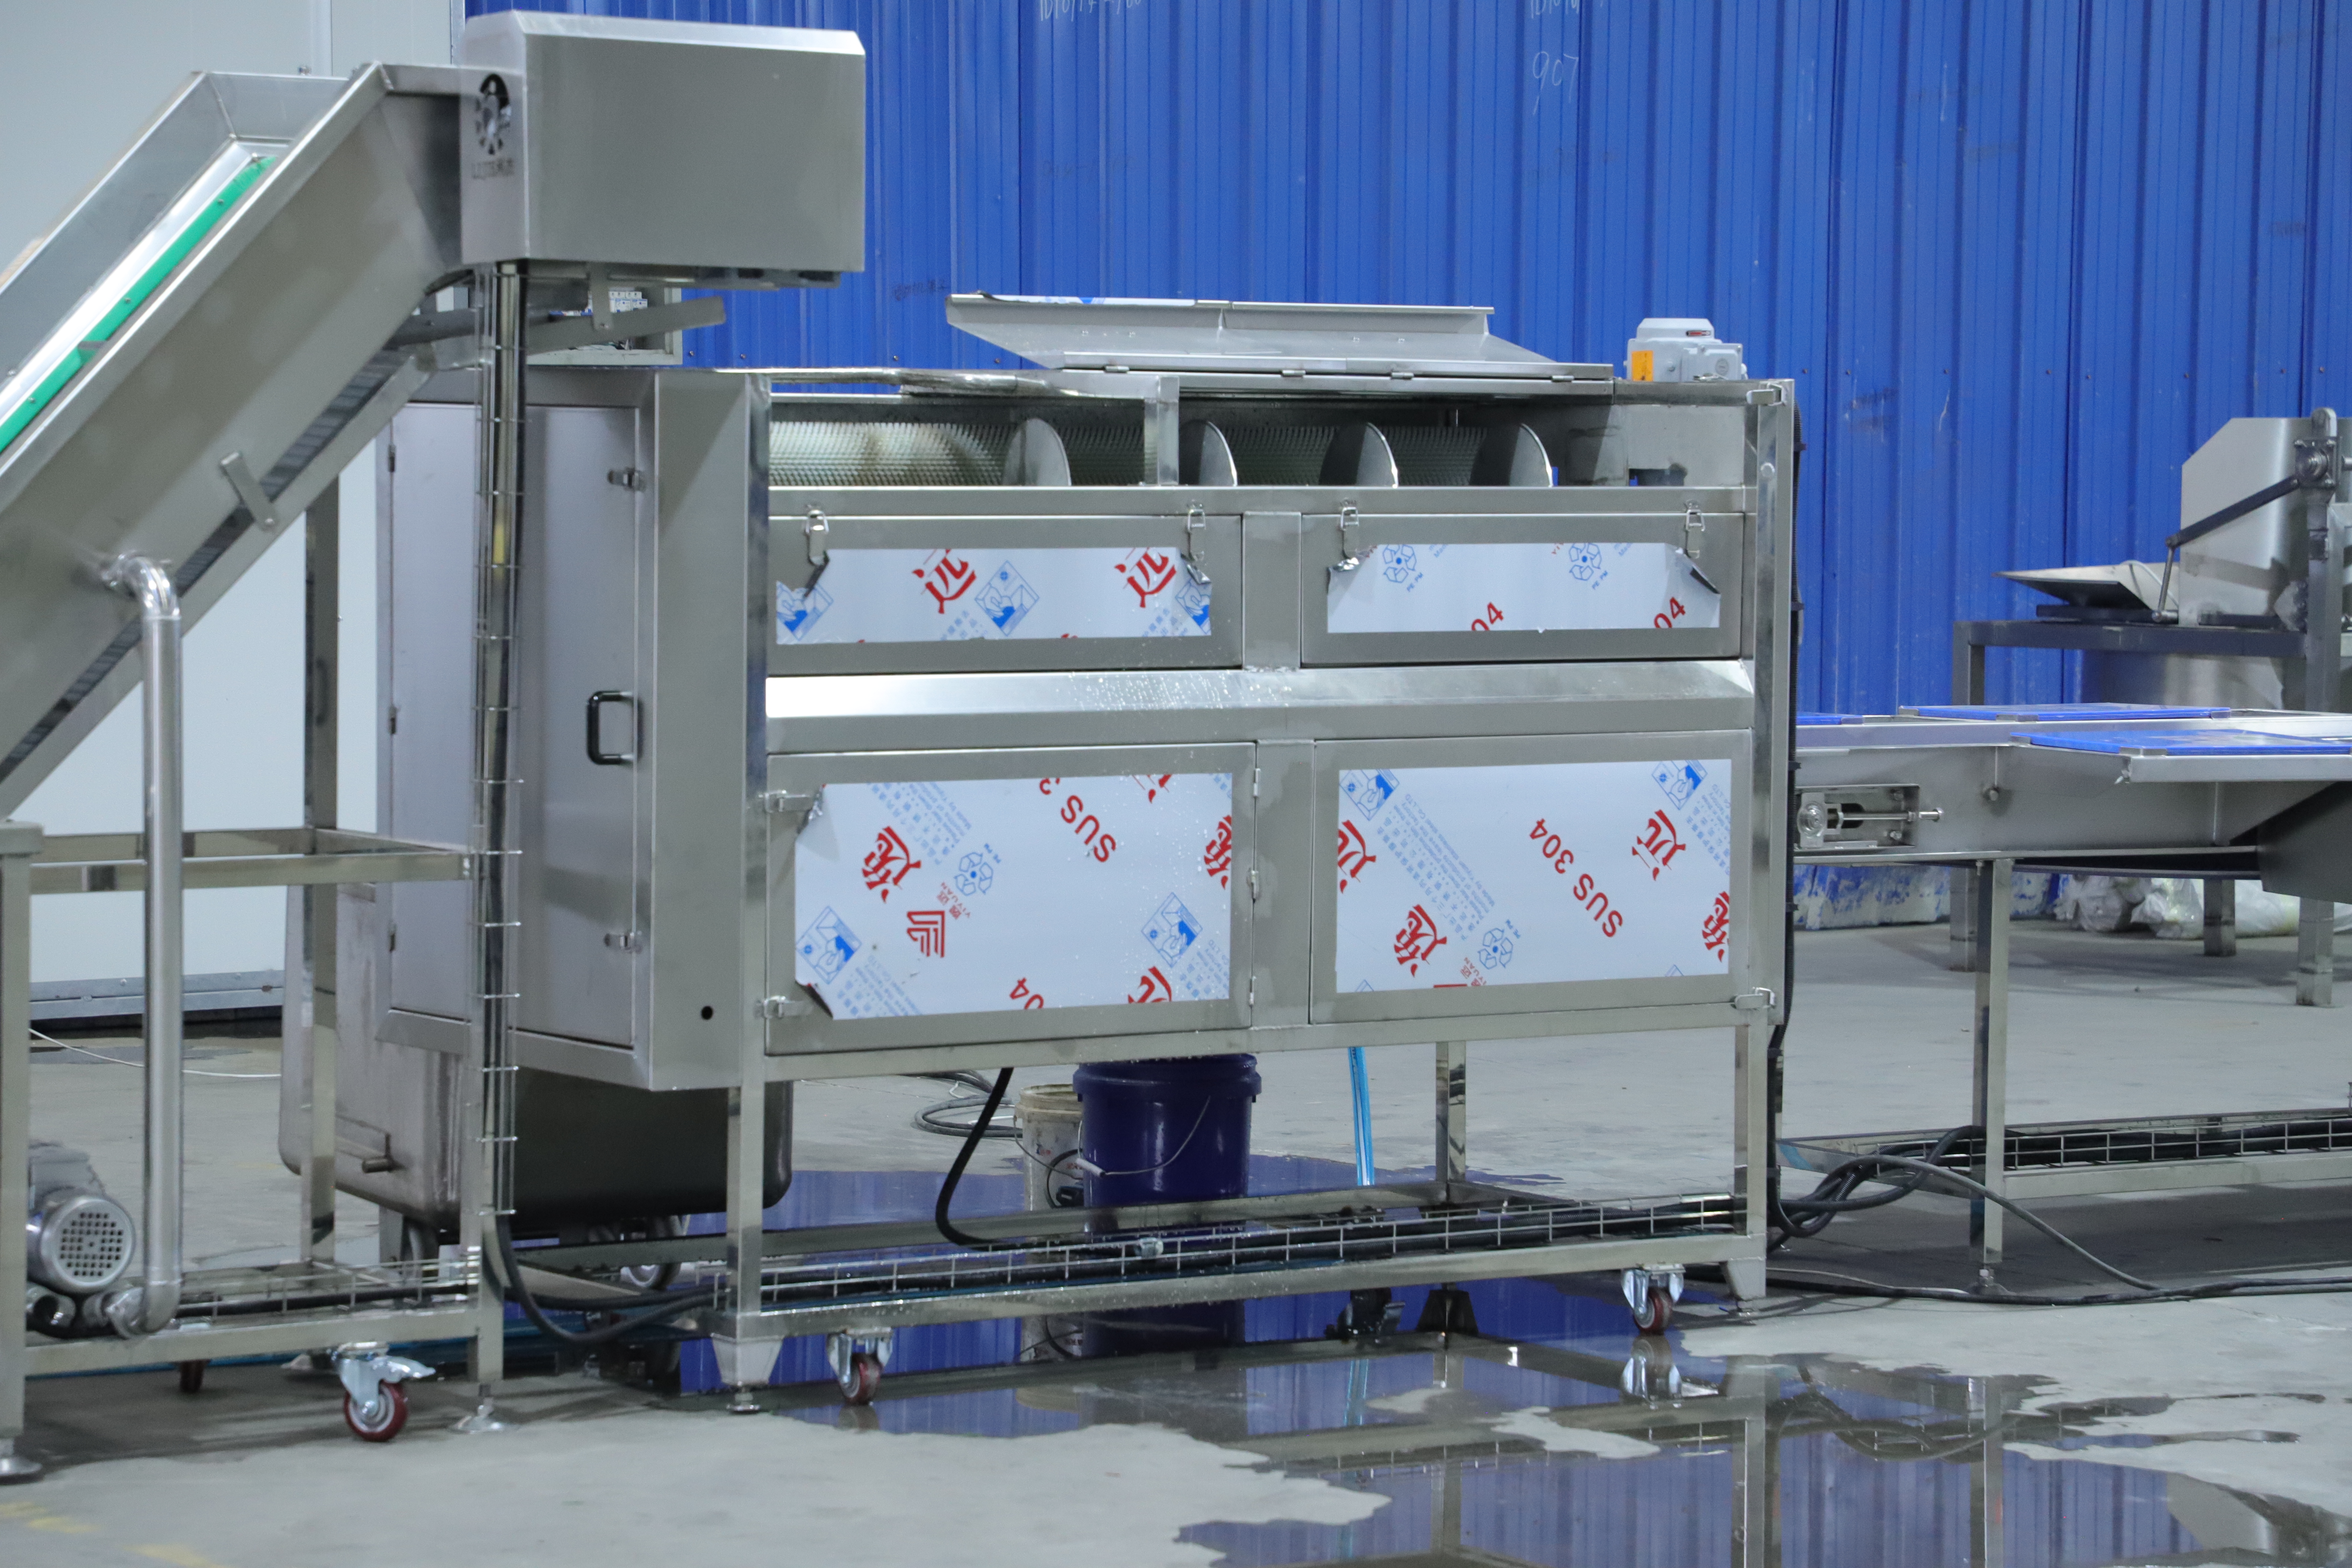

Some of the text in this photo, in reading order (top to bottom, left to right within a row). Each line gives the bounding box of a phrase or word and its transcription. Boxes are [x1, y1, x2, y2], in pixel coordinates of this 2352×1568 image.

[912, 548, 977, 614] 远
[1115, 547, 1177, 608] 远
[862, 825, 922, 902] 逸
[1061, 795, 1117, 863] SUS
[1204, 815, 1232, 889] 逸
[1336, 819, 1377, 893] 远
[1632, 809, 1686, 880] 远
[1530, 818, 1623, 938] SUS 304
[1393, 904, 1447, 977] 逸
[1702, 891, 1731, 961] 逸
